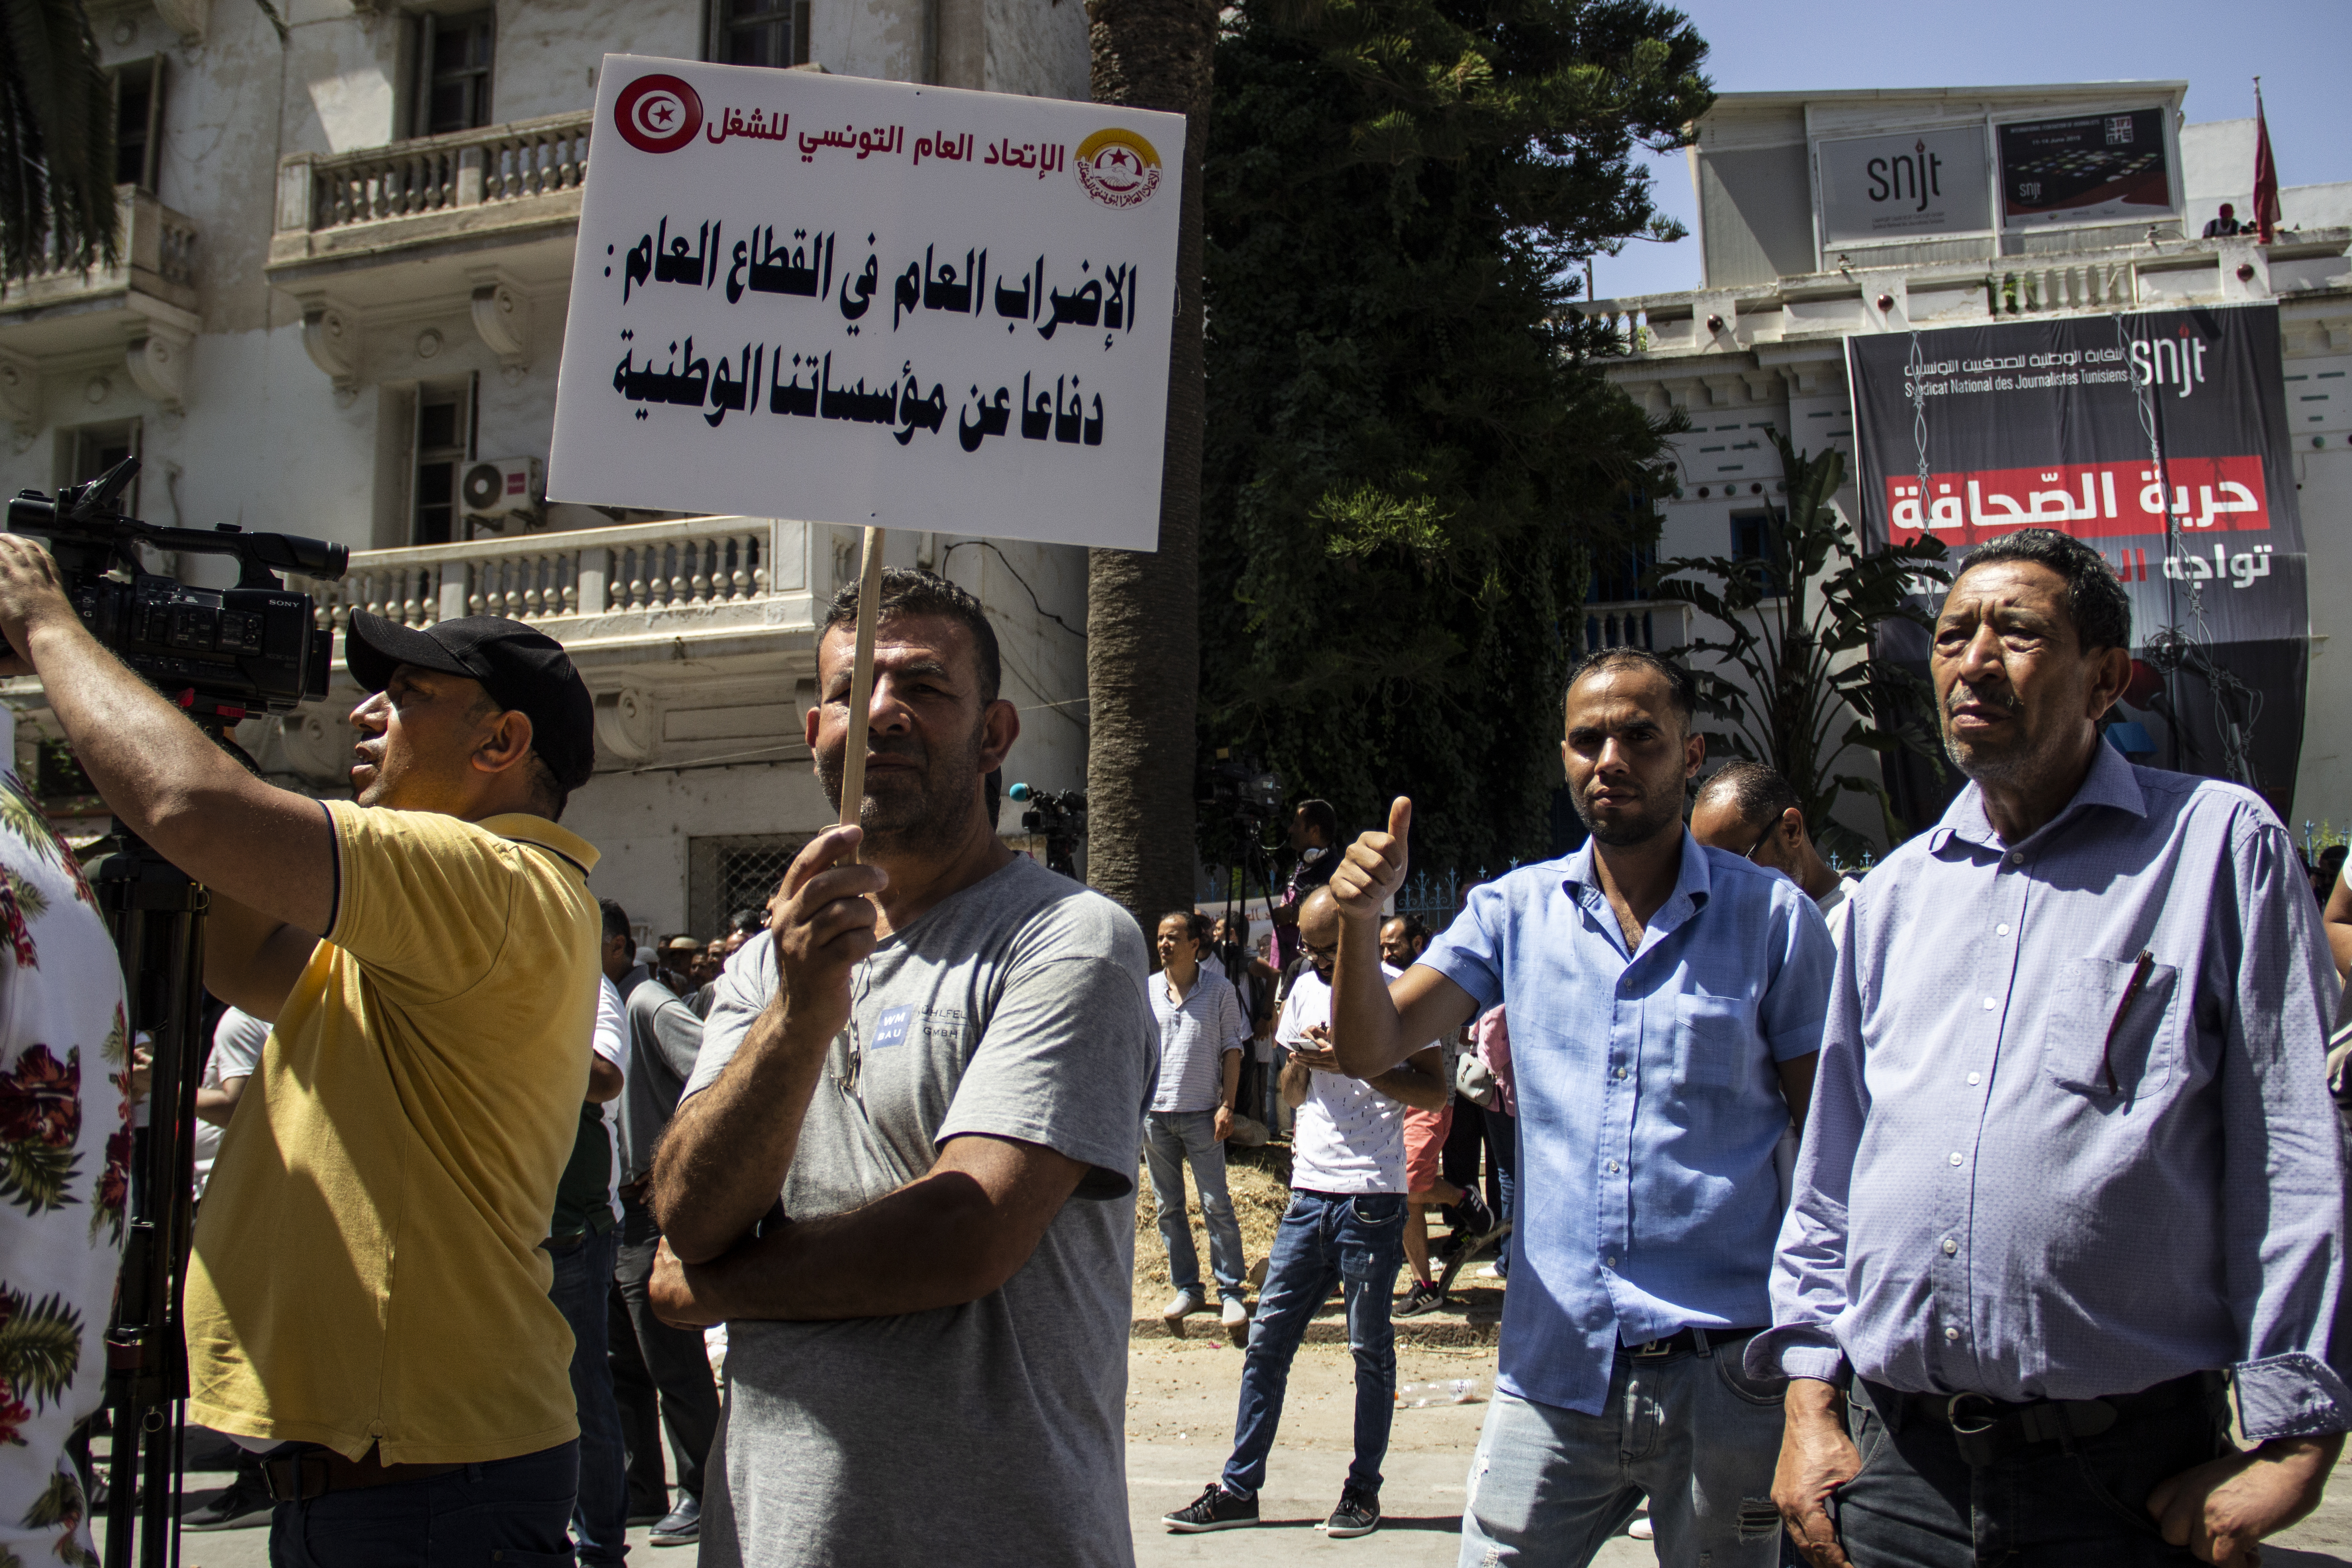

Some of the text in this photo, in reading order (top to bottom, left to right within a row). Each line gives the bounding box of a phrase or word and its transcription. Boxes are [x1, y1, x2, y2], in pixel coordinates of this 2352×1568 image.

[706, 107, 1065, 180] الإتحاد العام التونسي للشغل
[1867, 139, 1942, 212] snjt
[726, 224, 835, 305] القطاع
[839, 232, 878, 337] في
[894, 243, 987, 333] العام
[995, 254, 1137, 352] الإضراب
[613, 329, 1104, 453] دفاعا عن مؤسساتنا الوطنية
[1904, 359, 1959, 377] التونسين
[1950, 376, 1993, 394] National
[1995, 376, 2013, 391] des
[2015, 372, 2079, 390] Journalistes
[2080, 369, 2129, 384] Tunisiens
[2029, 349, 2082, 368] الوطنية
[2132, 324, 2207, 398] snjt
[2139, 469, 2259, 528] حرية
[2162, 543, 2273, 590] تواجه
[269, 599, 299, 608] SONY
[877, 1028, 902, 1041] BAU
[883, 1012, 906, 1027] WM
